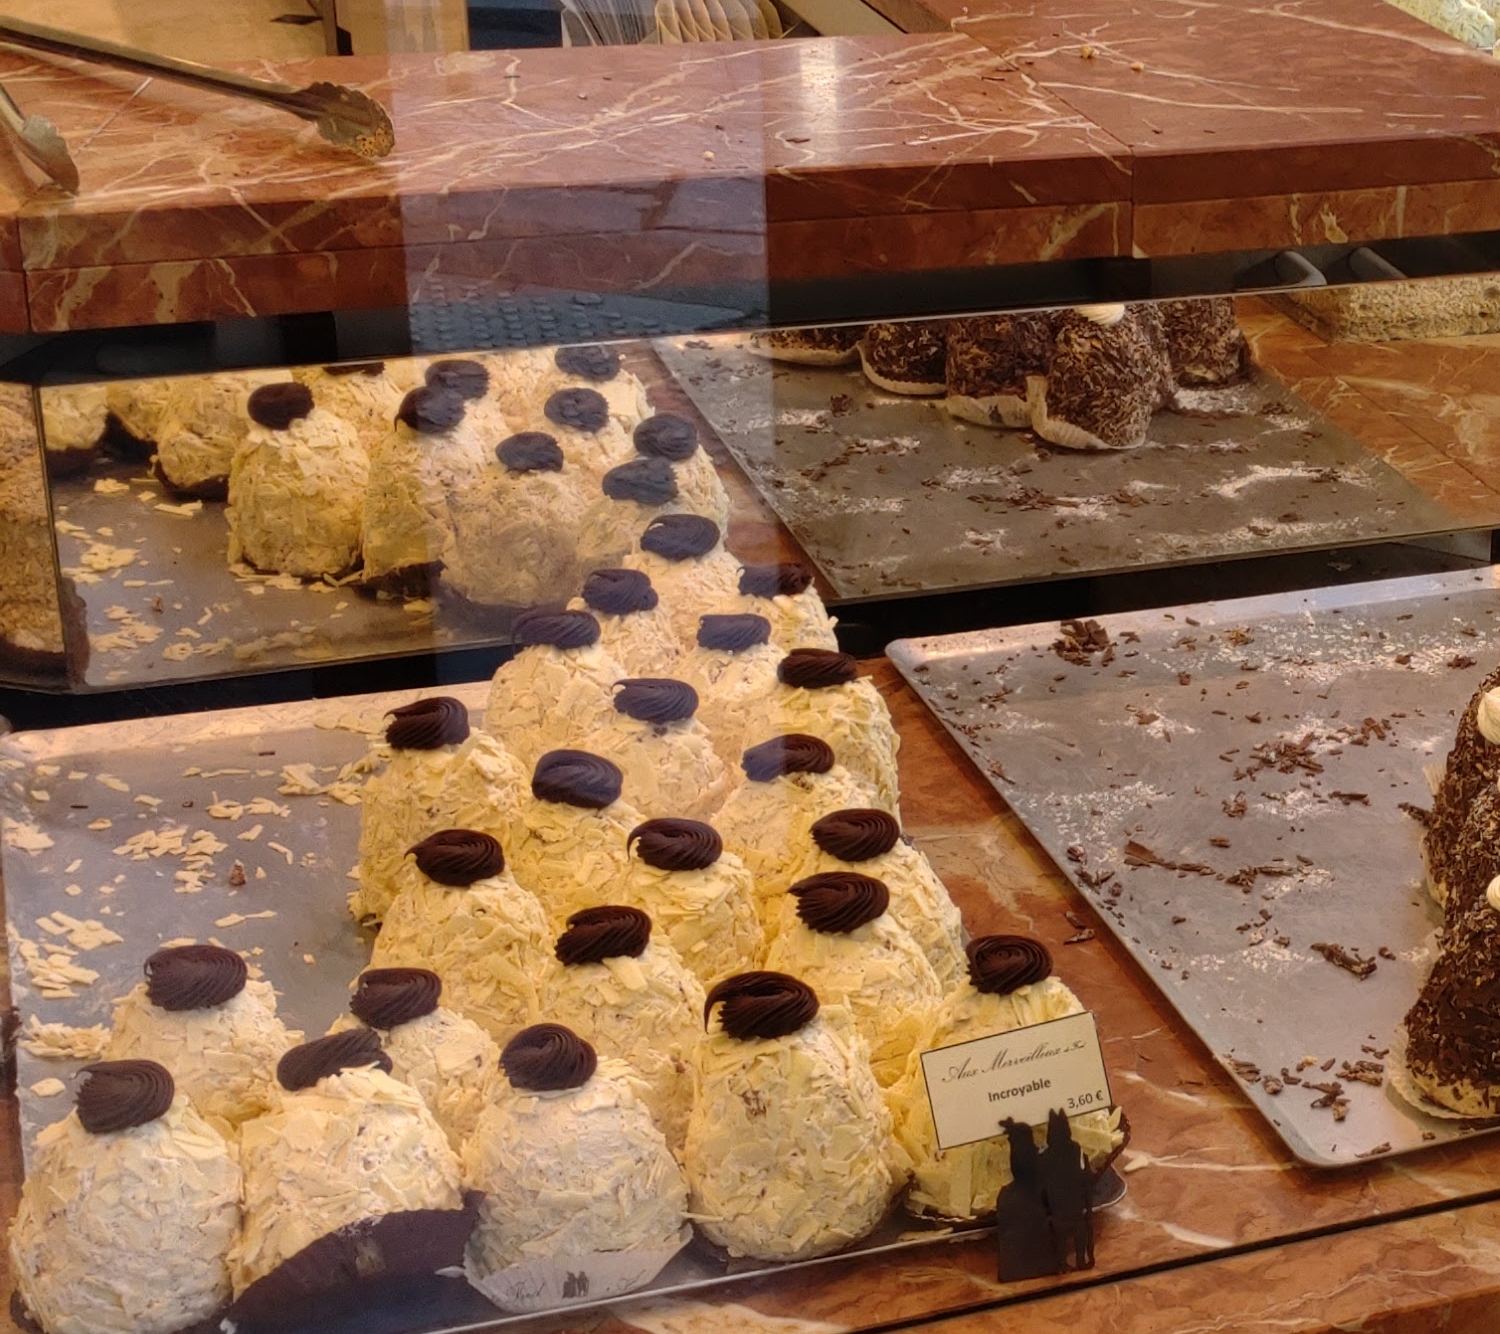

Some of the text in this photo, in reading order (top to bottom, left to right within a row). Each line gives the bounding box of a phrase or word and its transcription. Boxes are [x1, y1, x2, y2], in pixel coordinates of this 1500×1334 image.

[942, 1057, 977, 1082] Aux
[981, 1042, 1061, 1073] Merveilleux
[988, 1078, 1052, 1103] Incroyable
[1067, 1090, 1104, 1109] 3,60 €
